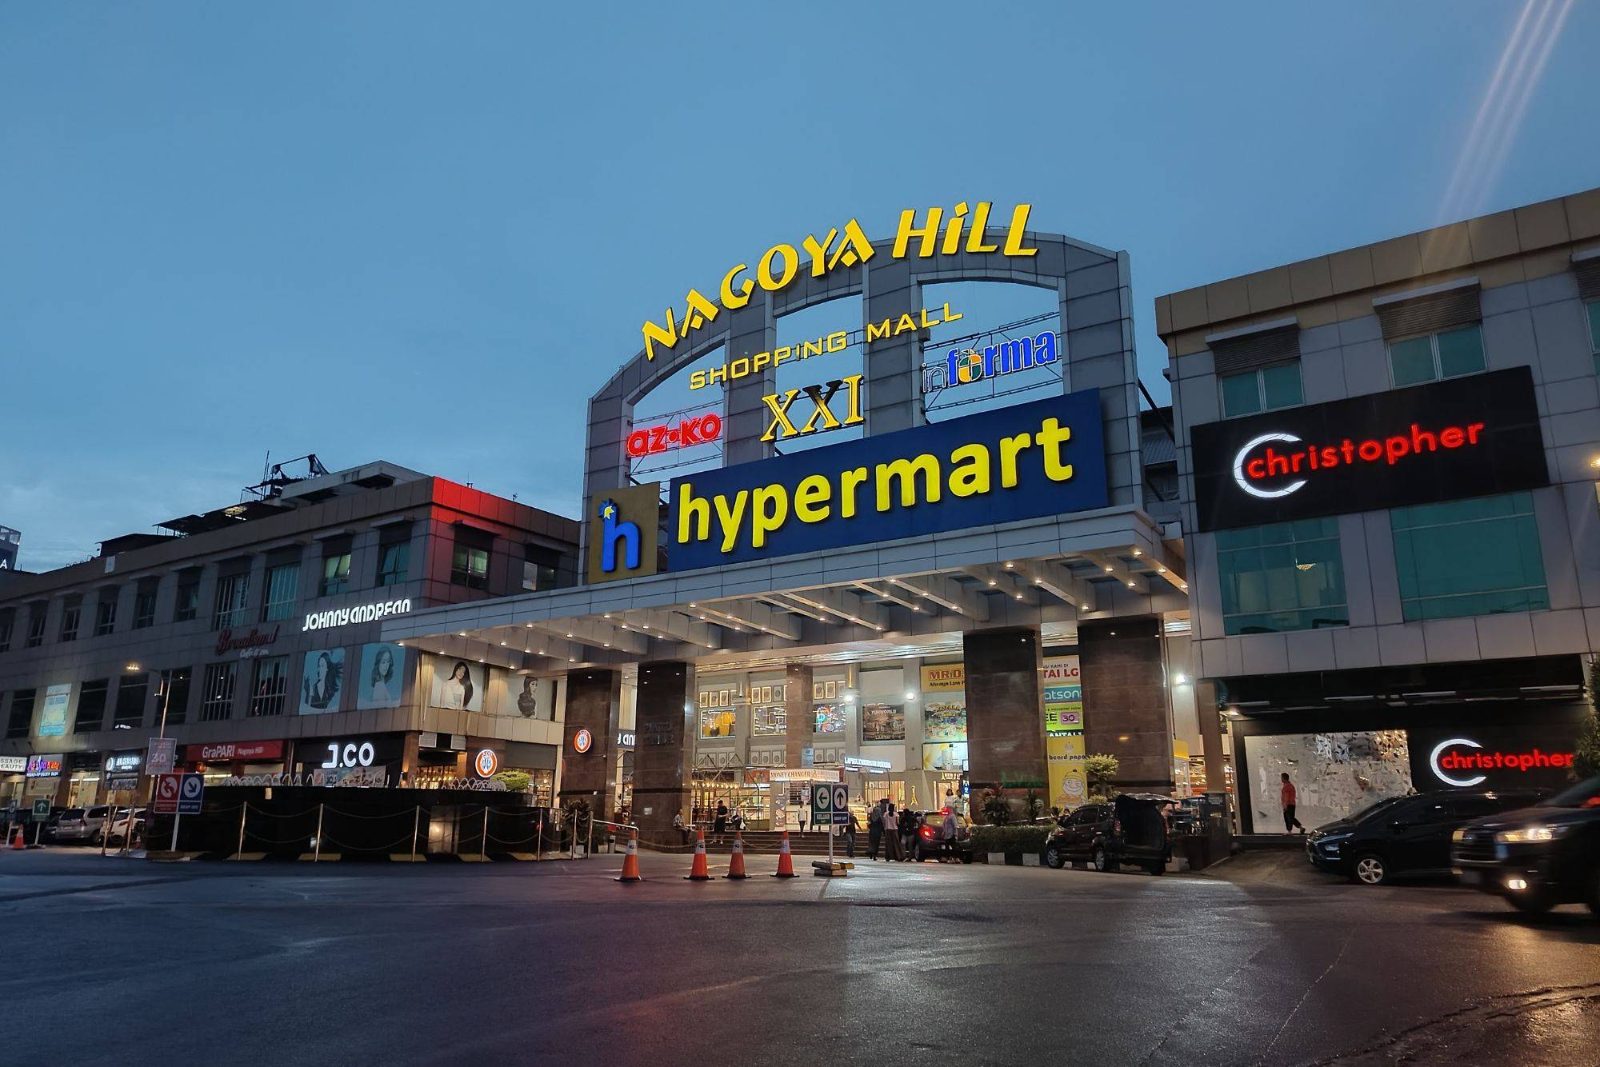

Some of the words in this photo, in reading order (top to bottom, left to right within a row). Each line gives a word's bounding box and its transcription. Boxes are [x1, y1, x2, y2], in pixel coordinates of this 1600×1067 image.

[640, 218, 875, 361] NAGOYA
[689, 330, 848, 391] SHOPPING
[867, 302, 964, 343] MALL
[760, 374, 865, 442] XXI
[677, 417, 1076, 554] hypermart
[1064, 668, 1078, 677] LG
[202, 745, 235, 758] GraPARI
[322, 742, 374, 769] J.CO
